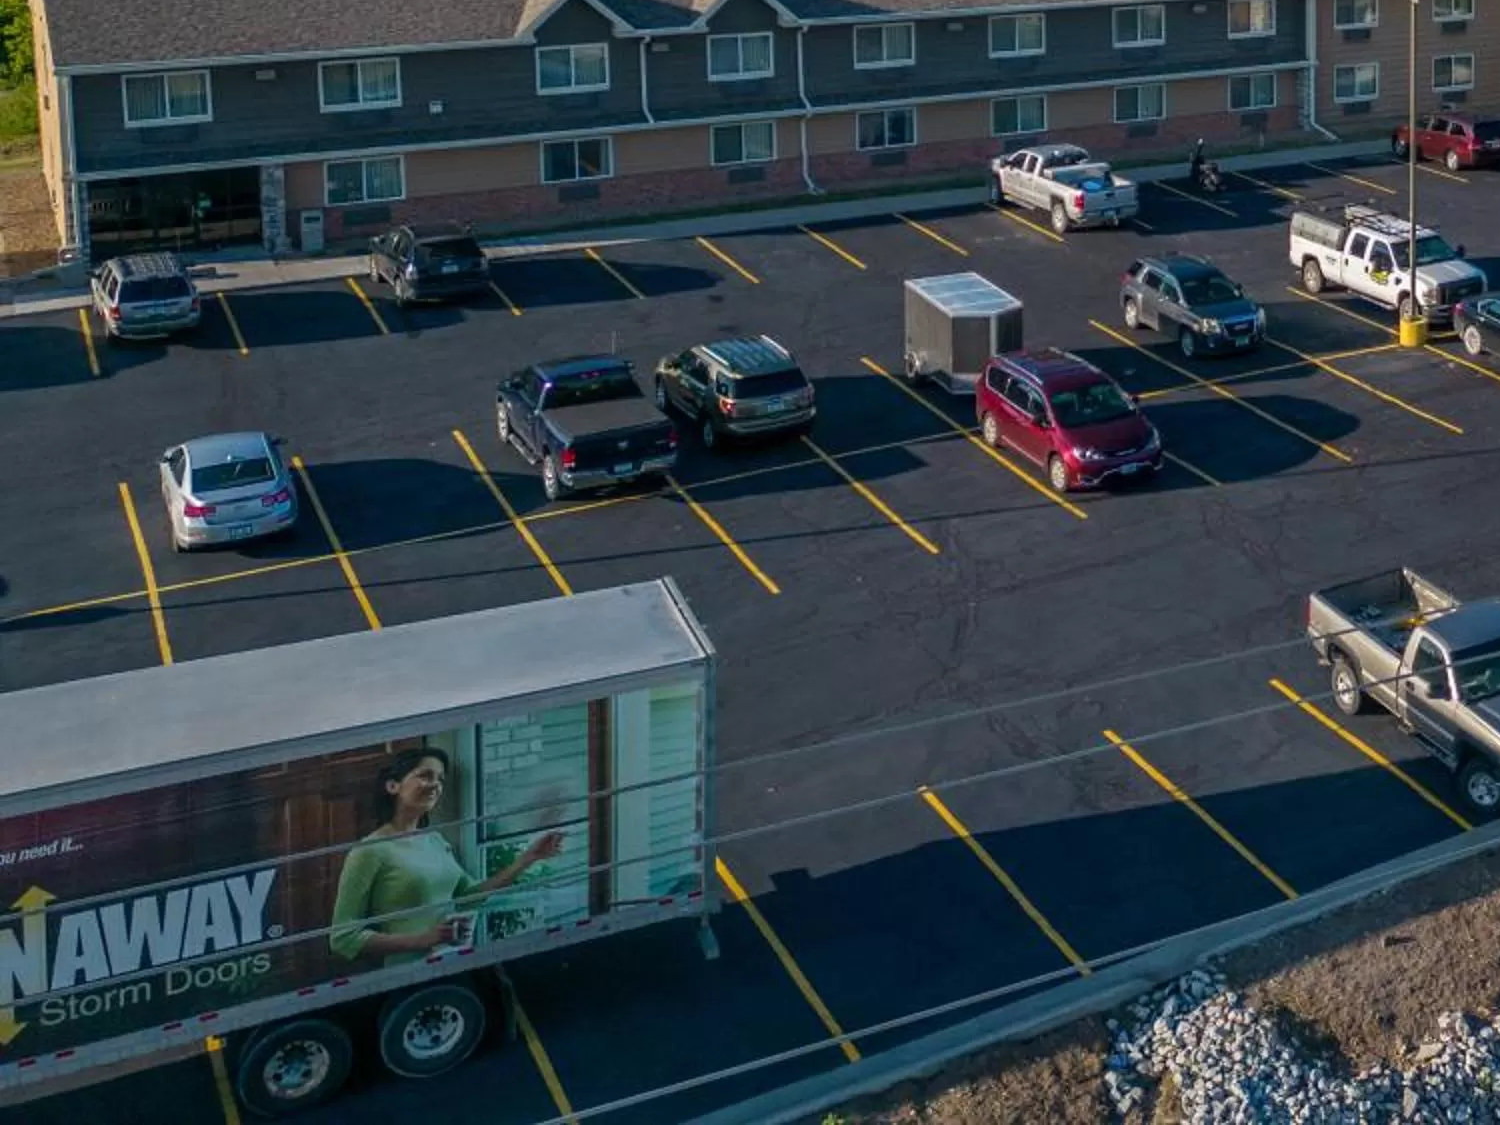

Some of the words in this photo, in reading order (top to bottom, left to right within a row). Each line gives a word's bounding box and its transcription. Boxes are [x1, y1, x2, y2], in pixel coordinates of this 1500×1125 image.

[18, 840, 59, 862] need
[39, 981, 151, 1027] Storm
[165, 952, 272, 996] Doors
